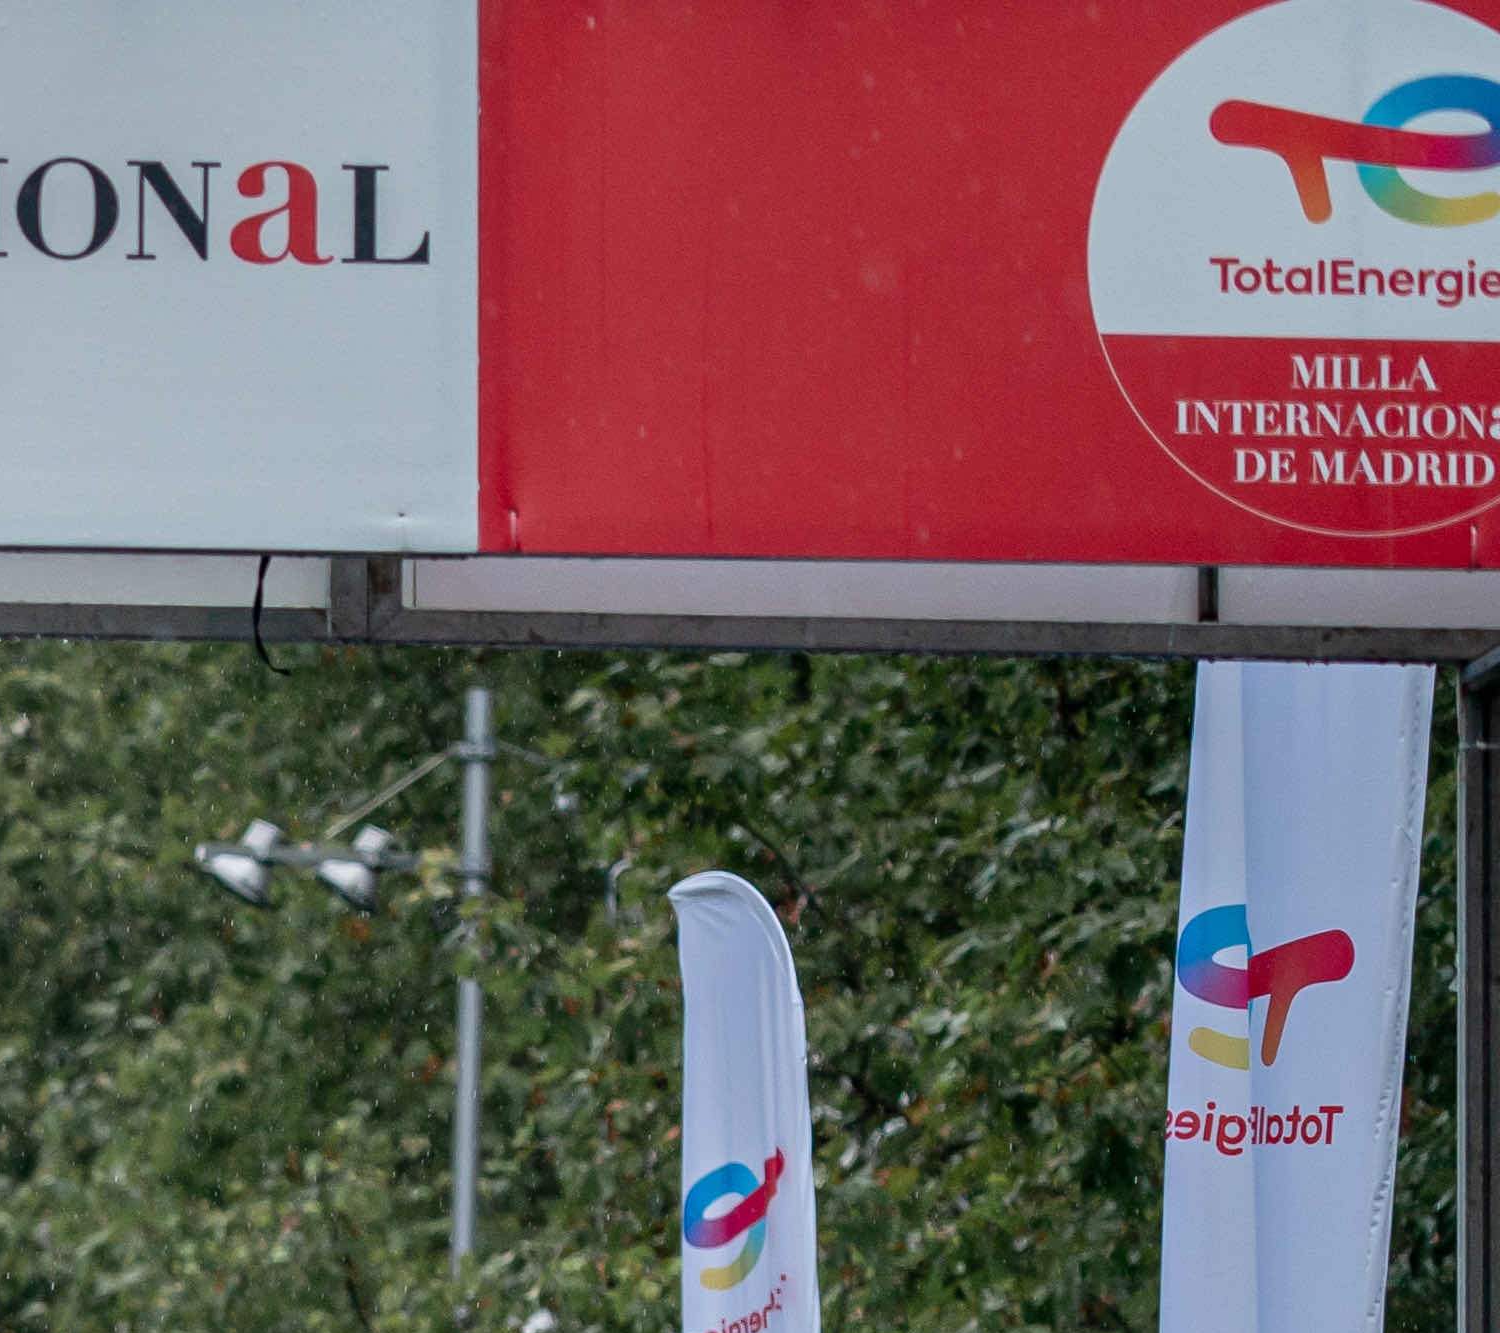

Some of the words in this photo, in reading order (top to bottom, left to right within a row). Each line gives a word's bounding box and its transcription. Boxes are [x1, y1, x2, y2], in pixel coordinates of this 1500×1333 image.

[1209, 256, 1500, 308] TotalEnergie
[1291, 354, 1437, 392] MILLA
[1174, 399, 1500, 441] INTERNACION
[1233, 448, 1297, 484] DE
[1311, 450, 1495, 487] MADRID
